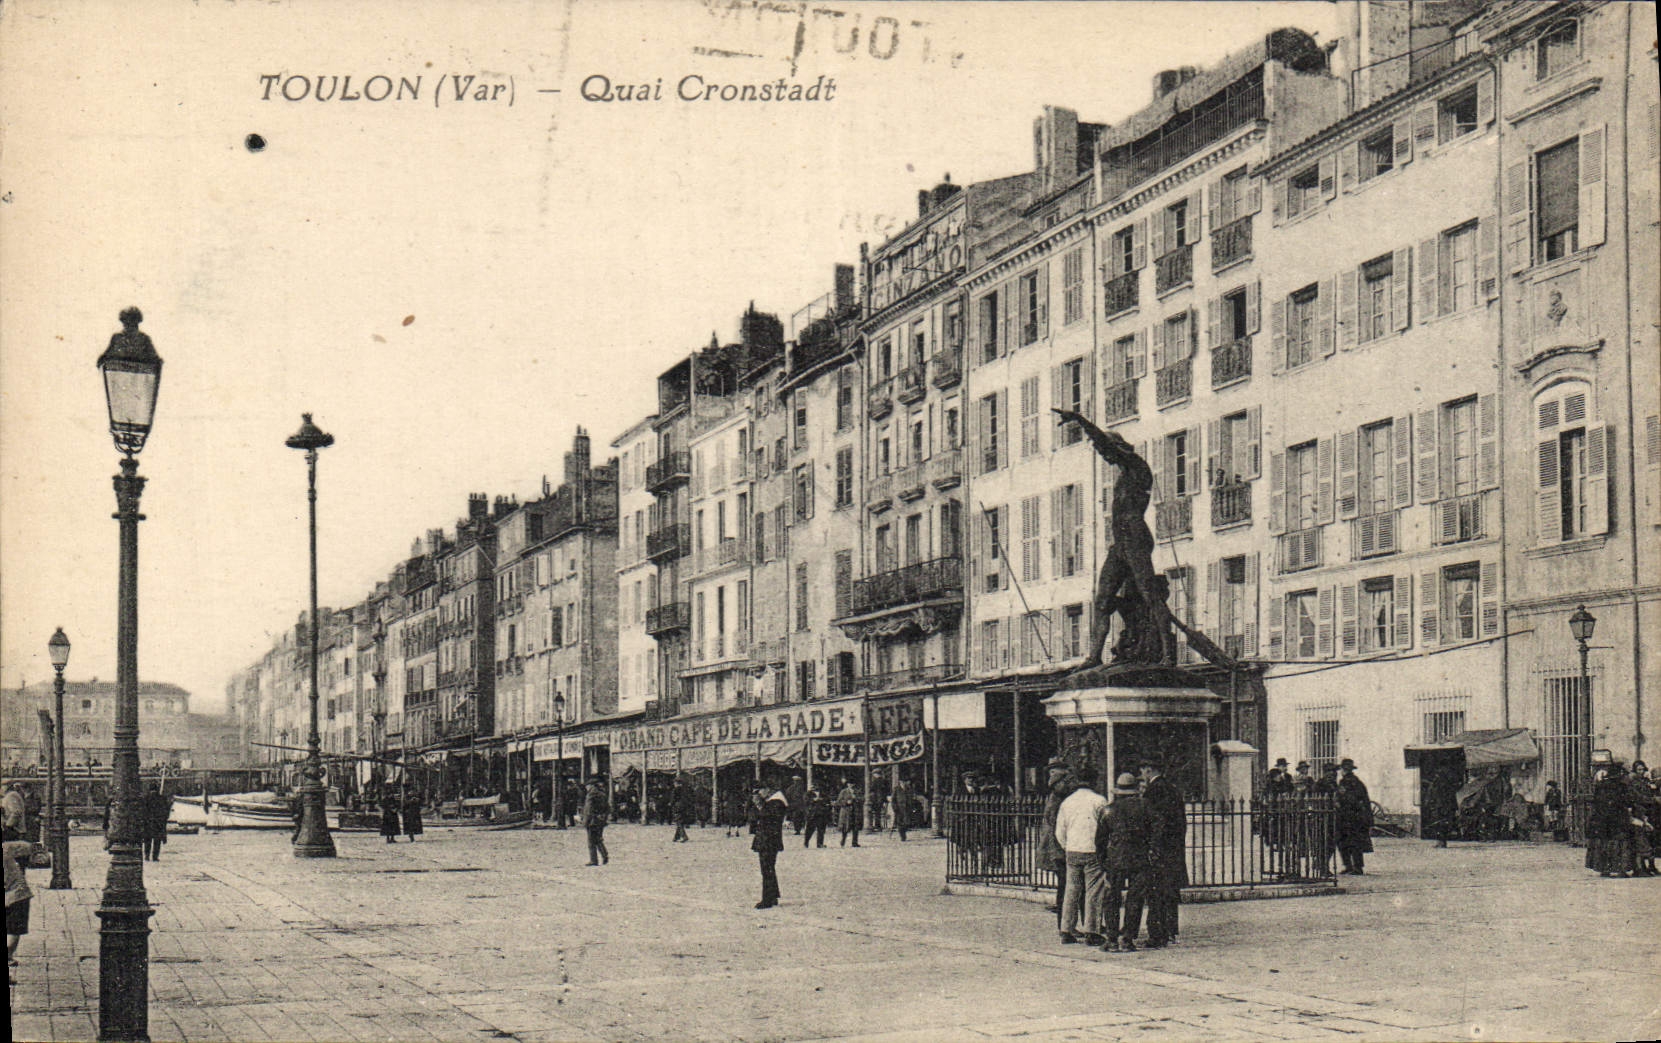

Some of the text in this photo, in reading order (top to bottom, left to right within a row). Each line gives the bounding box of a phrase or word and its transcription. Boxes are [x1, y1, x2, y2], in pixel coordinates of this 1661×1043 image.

[718, 716, 742, 741] DE
[746, 716, 773, 739] LA
[777, 707, 844, 737] RADE
